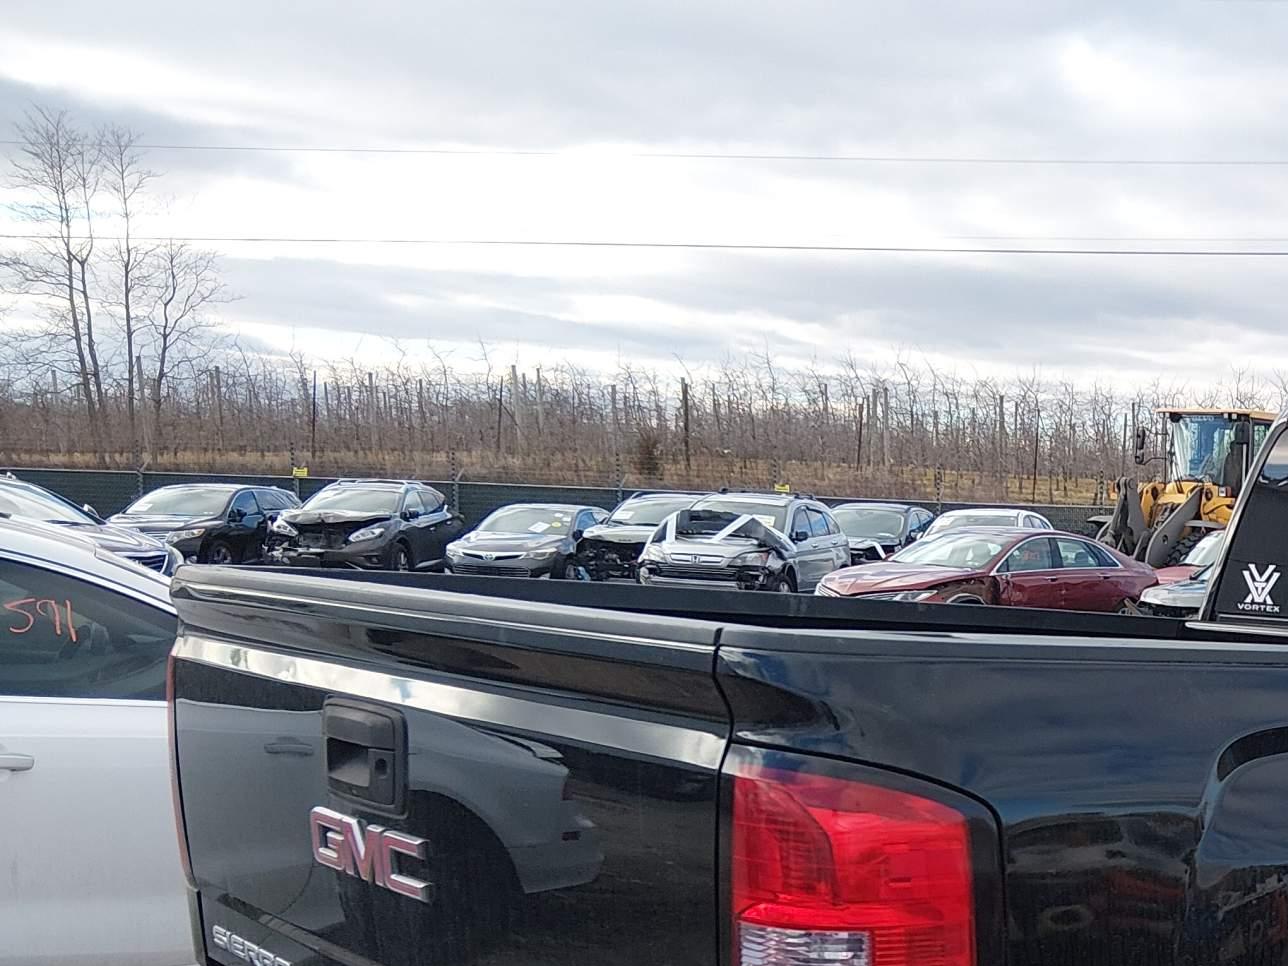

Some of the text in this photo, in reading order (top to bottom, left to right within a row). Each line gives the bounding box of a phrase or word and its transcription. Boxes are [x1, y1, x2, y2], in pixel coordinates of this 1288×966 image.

[3, 598, 77, 642] 591
[1237, 602, 1280, 613] VORTEX
[310, 806, 433, 904] GMC
